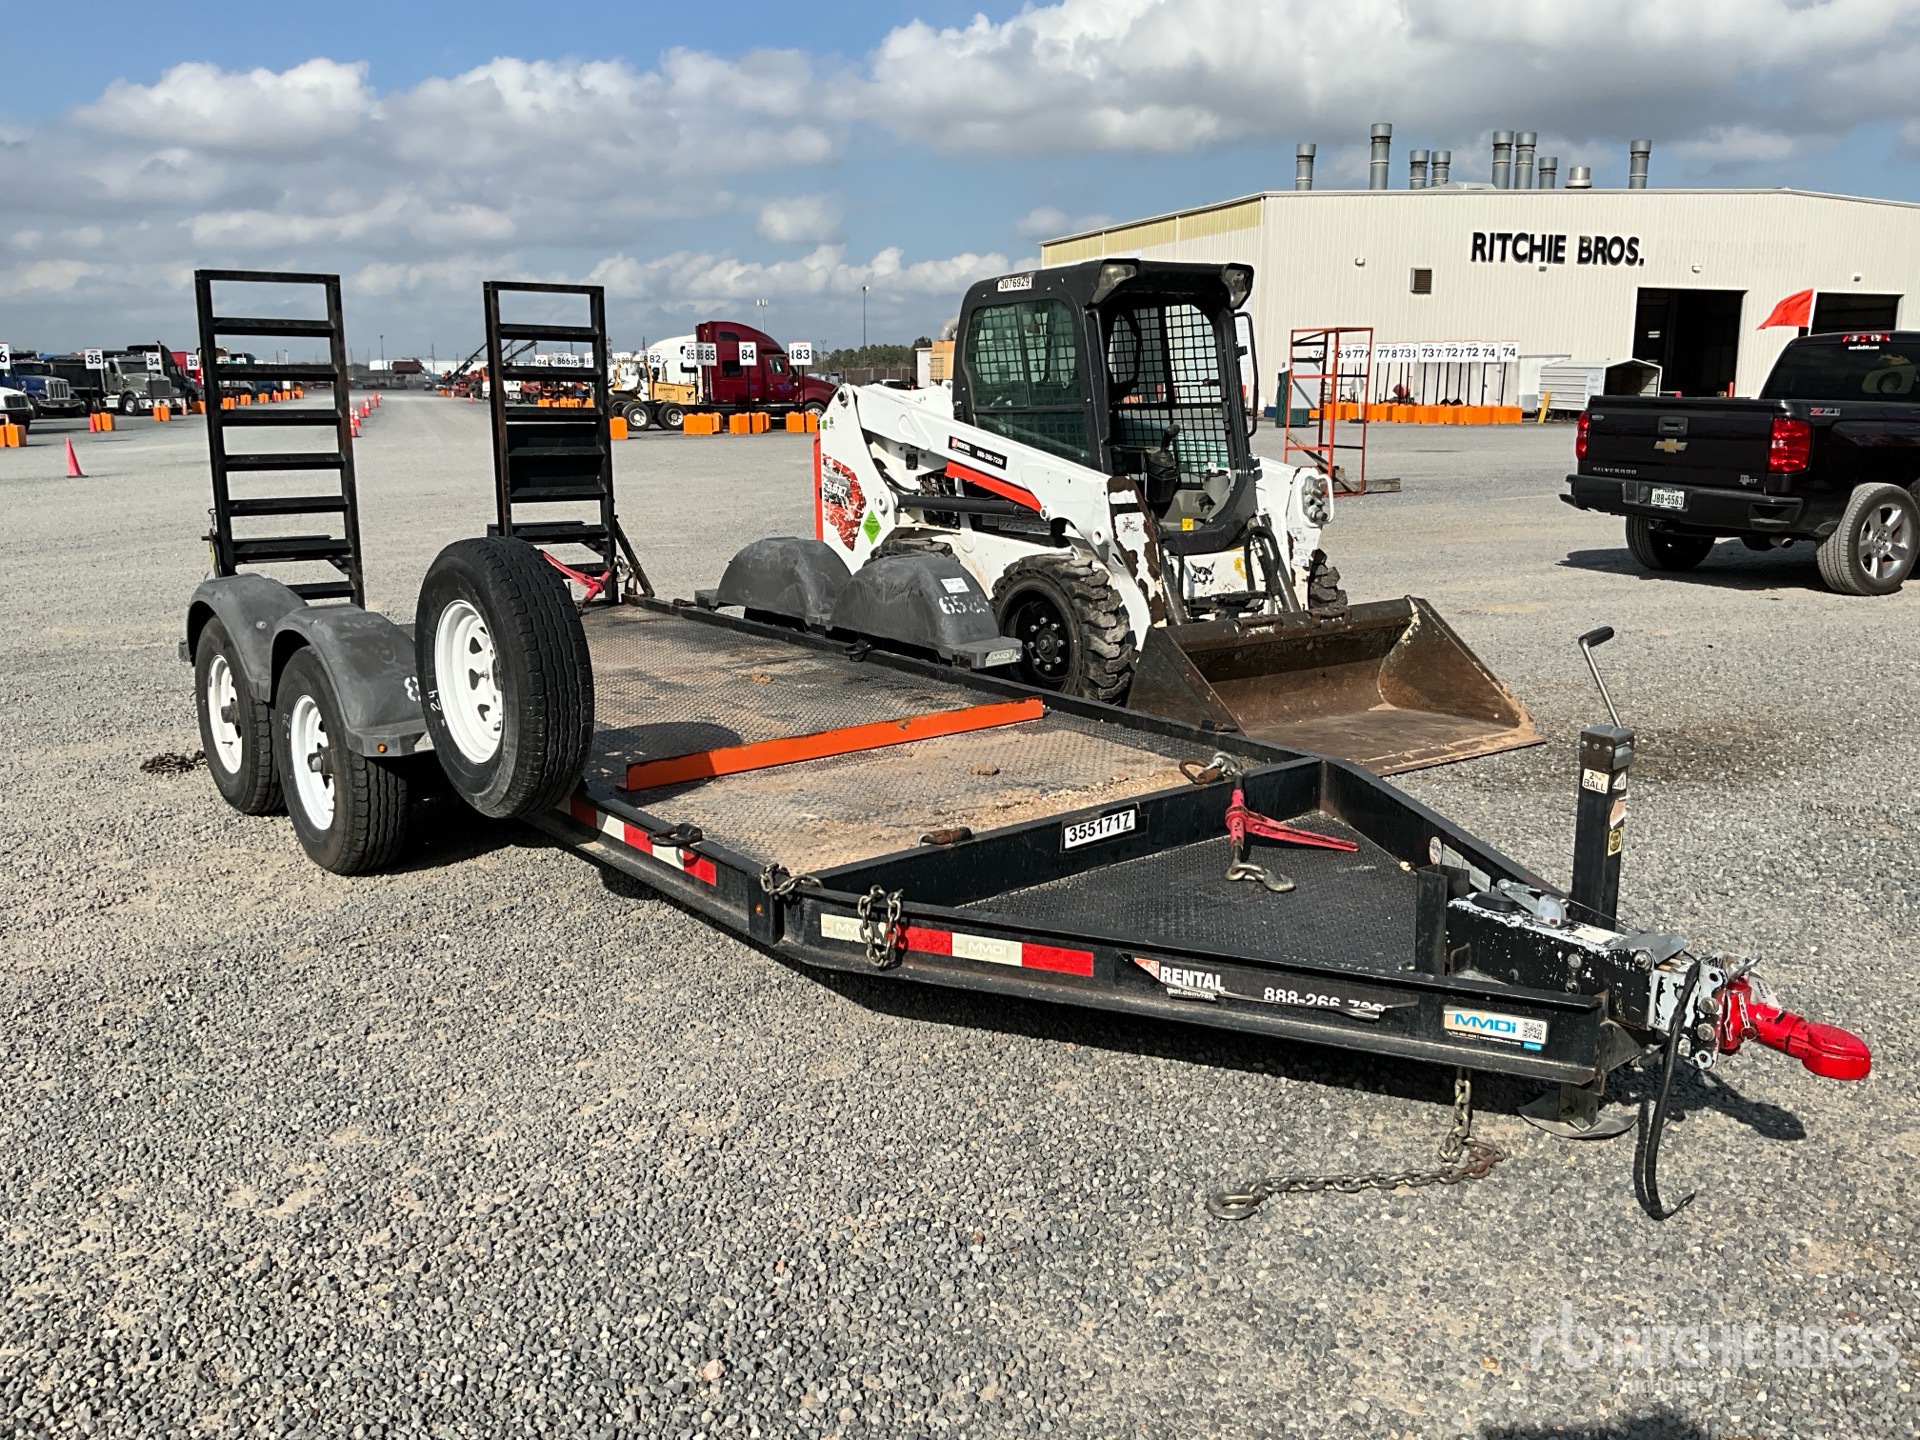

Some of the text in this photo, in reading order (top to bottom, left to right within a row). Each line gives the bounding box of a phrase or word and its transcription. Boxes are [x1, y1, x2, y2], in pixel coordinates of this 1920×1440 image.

[1470, 232, 1645, 267] RITCHIE BROS.
[686, 349, 695, 360] 85
[705, 349, 715, 360] 85
[741, 349, 755, 360] 84
[796, 349, 810, 360] 83
[1353, 349, 1364, 358] 77
[1378, 349, 1389, 358] 77
[1399, 348, 1411, 358] 73
[1421, 348, 1434, 357] 73
[1445, 347, 1458, 357] 72
[1466, 347, 1479, 356] 72
[1483, 348, 1495, 357] 74
[1502, 347, 1516, 356] 74
[87, 354, 101, 365] 35
[148, 357, 160, 366] 34
[188, 358, 198, 367] 33
[649, 354, 661, 363] 82
[1583, 778, 1606, 792] BALL
[1069, 812, 1132, 842] 3551717
[1160, 966, 1225, 992] RENTAL
